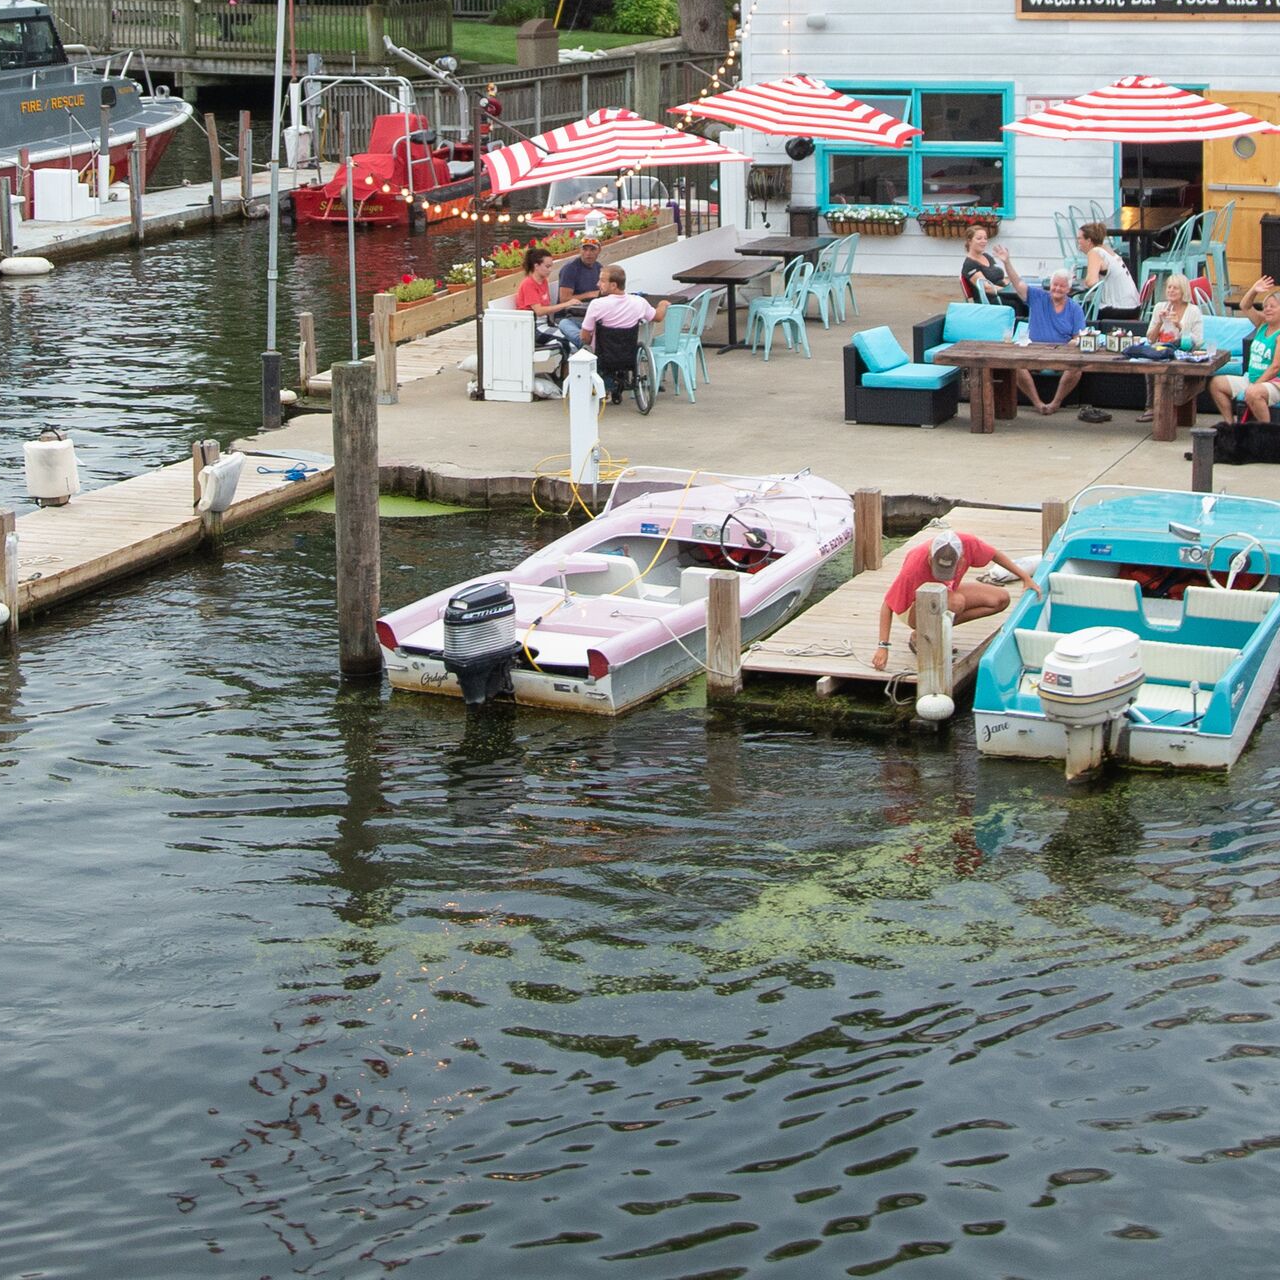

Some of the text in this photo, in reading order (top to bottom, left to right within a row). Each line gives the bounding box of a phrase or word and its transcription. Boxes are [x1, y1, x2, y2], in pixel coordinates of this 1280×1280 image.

[21, 100, 43, 113] FIRE
[51, 94, 85, 109] RESCUE
[982, 722, 1009, 742] Jane
